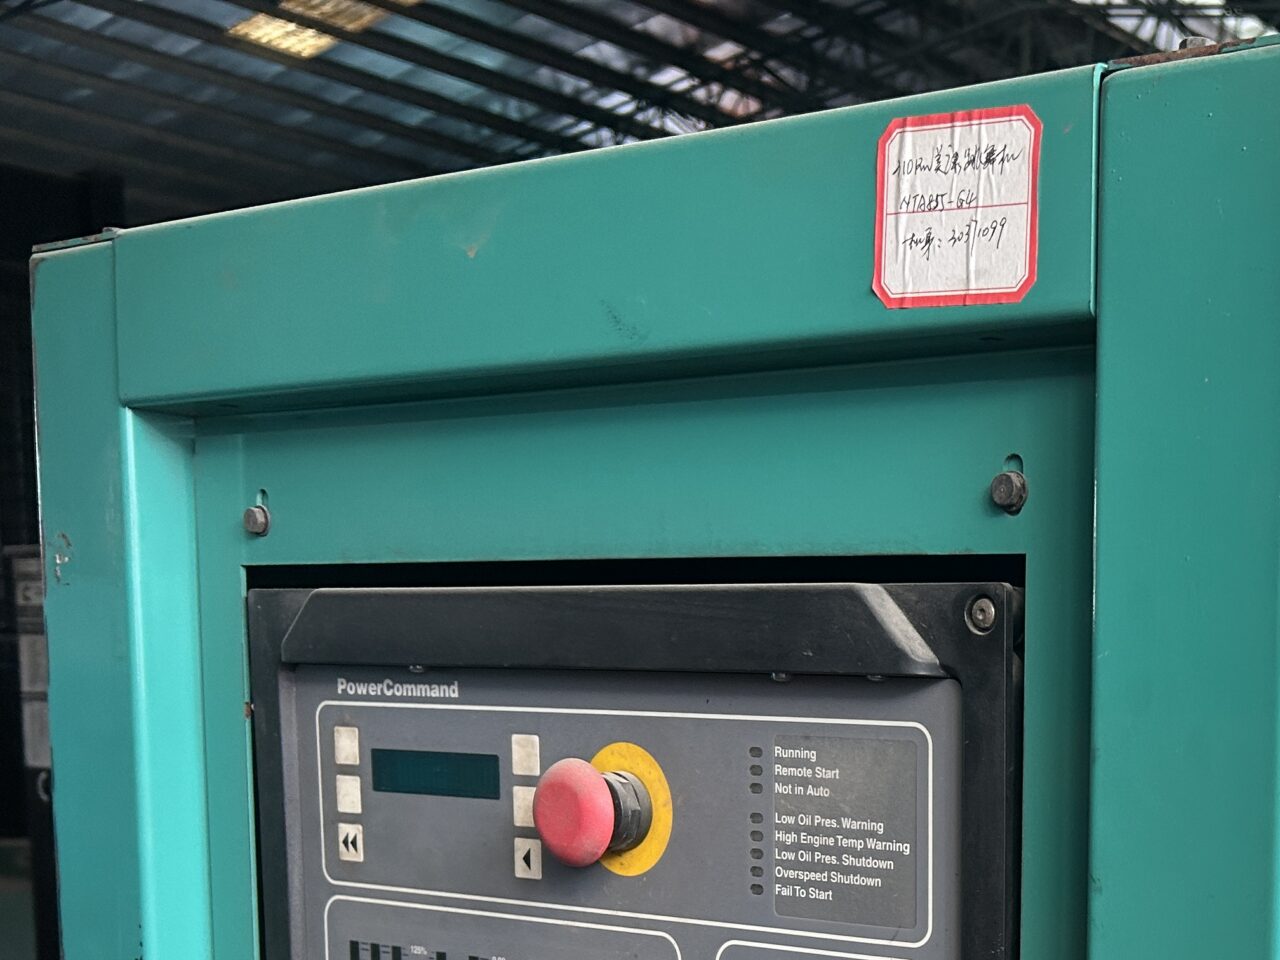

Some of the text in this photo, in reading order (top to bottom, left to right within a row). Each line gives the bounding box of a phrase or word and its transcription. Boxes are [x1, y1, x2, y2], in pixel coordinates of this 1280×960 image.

[337, 678, 459, 697] PowerCommand
[775, 746, 817, 762] Running
[775, 764, 839, 779] Remote Start
[775, 783, 830, 797] Not in Auto
[775, 813, 884, 834] Low Oil Pres. Warning
[775, 830, 910, 855] High Engine Temp Warning
[775, 848, 894, 870] Low Oil Pres. Shutdown
[775, 866, 881, 887] Overspeed Shutdown
[775, 884, 832, 900] Fail To Start
